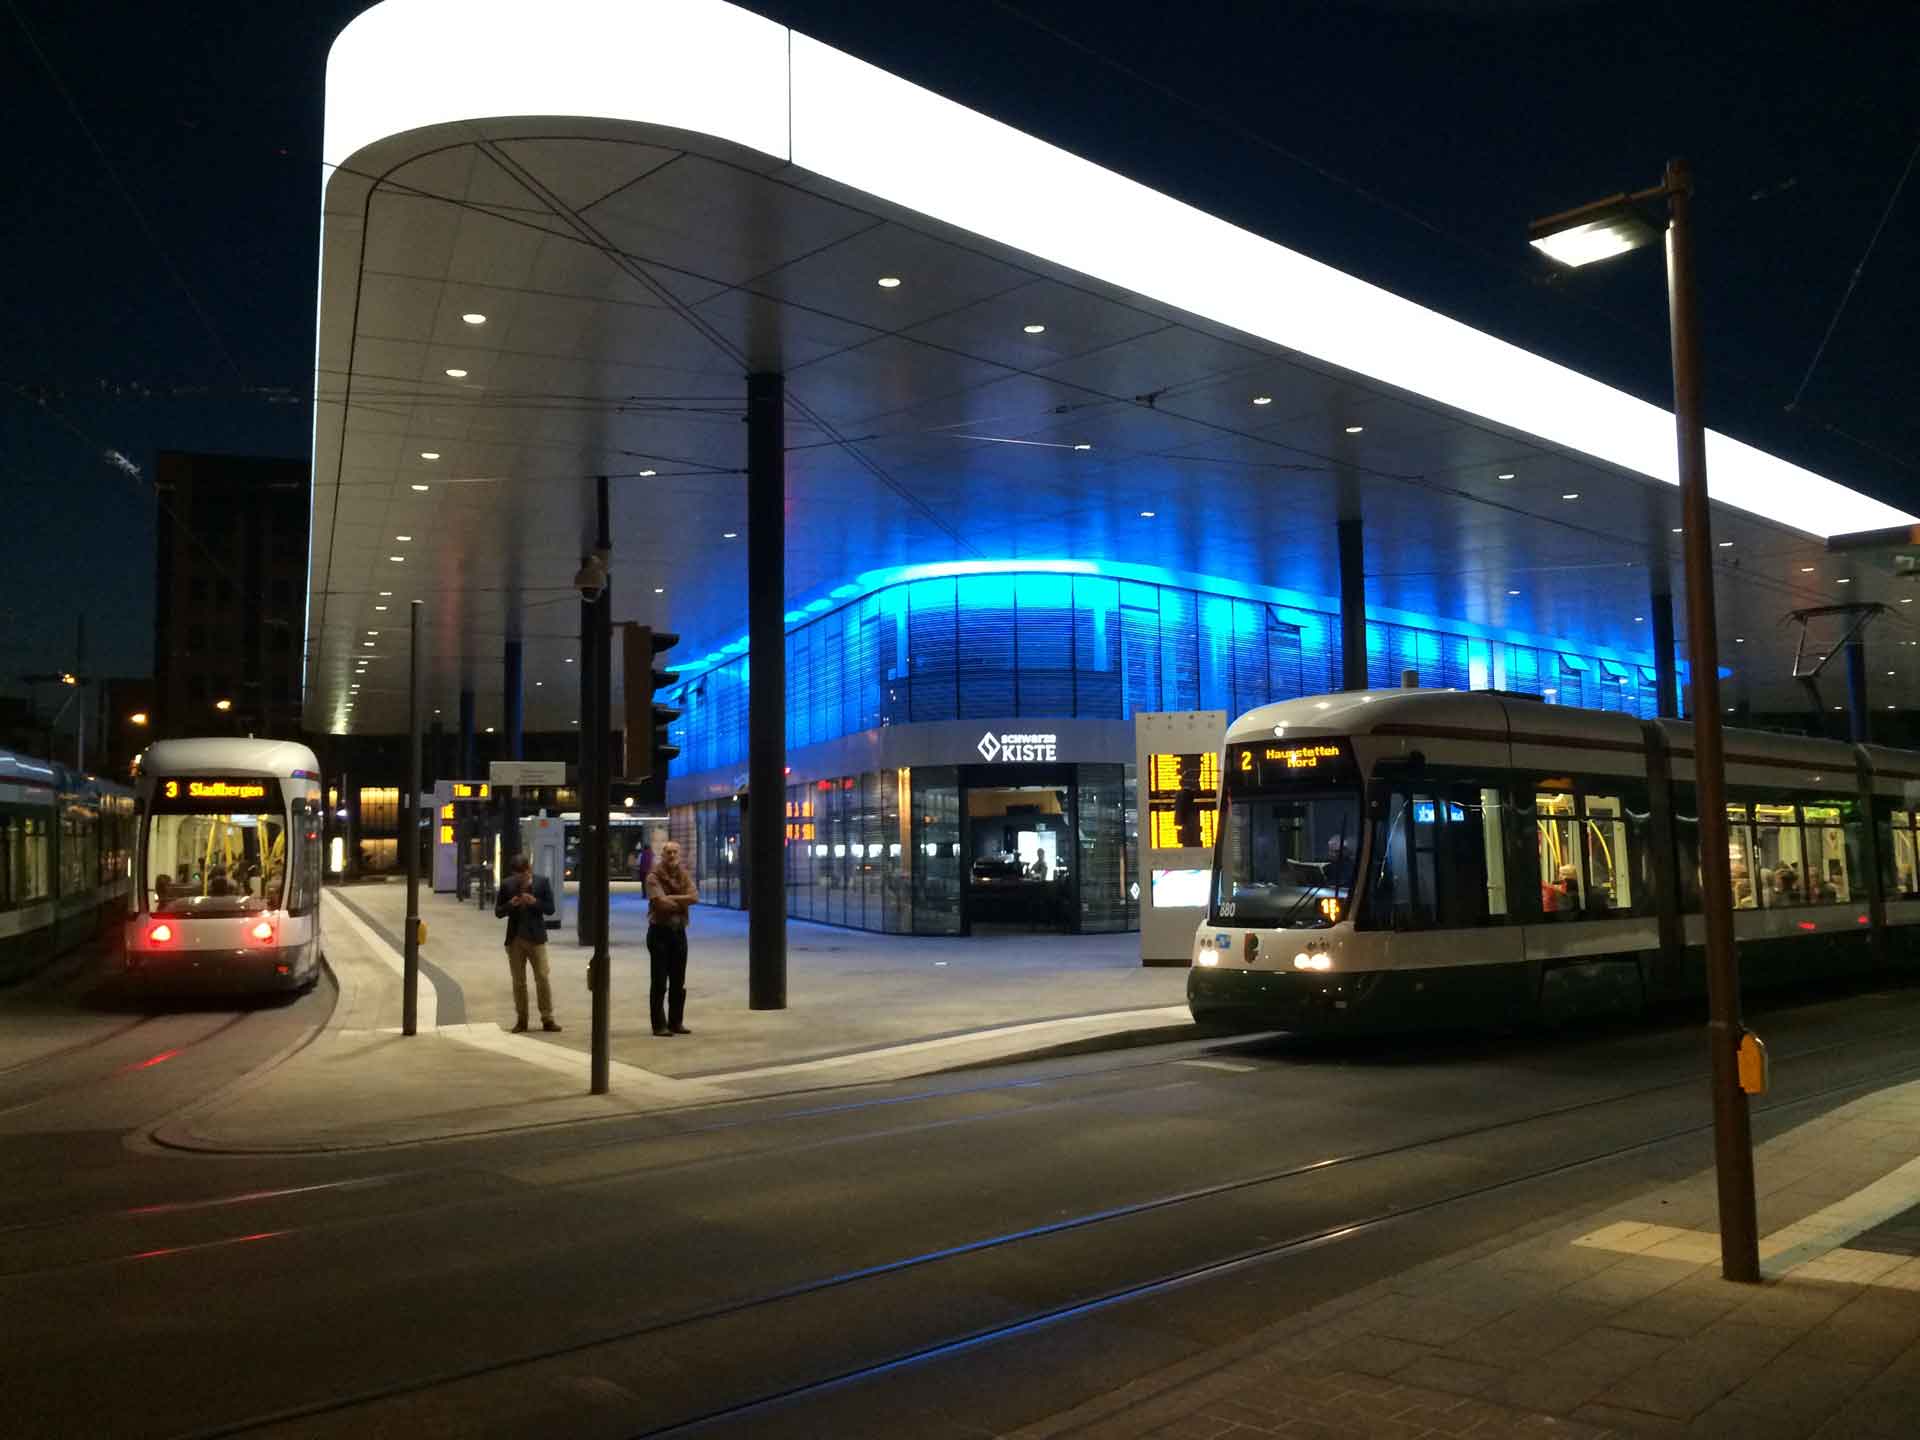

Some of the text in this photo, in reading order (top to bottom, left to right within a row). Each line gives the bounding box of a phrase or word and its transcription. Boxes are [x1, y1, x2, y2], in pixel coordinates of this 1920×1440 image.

[1002, 744, 1057, 762] KISTE
[1241, 746, 1340, 771] 2 Haunstetten
[1287, 756, 1317, 768] Nord
[165, 781, 177, 798] 3
